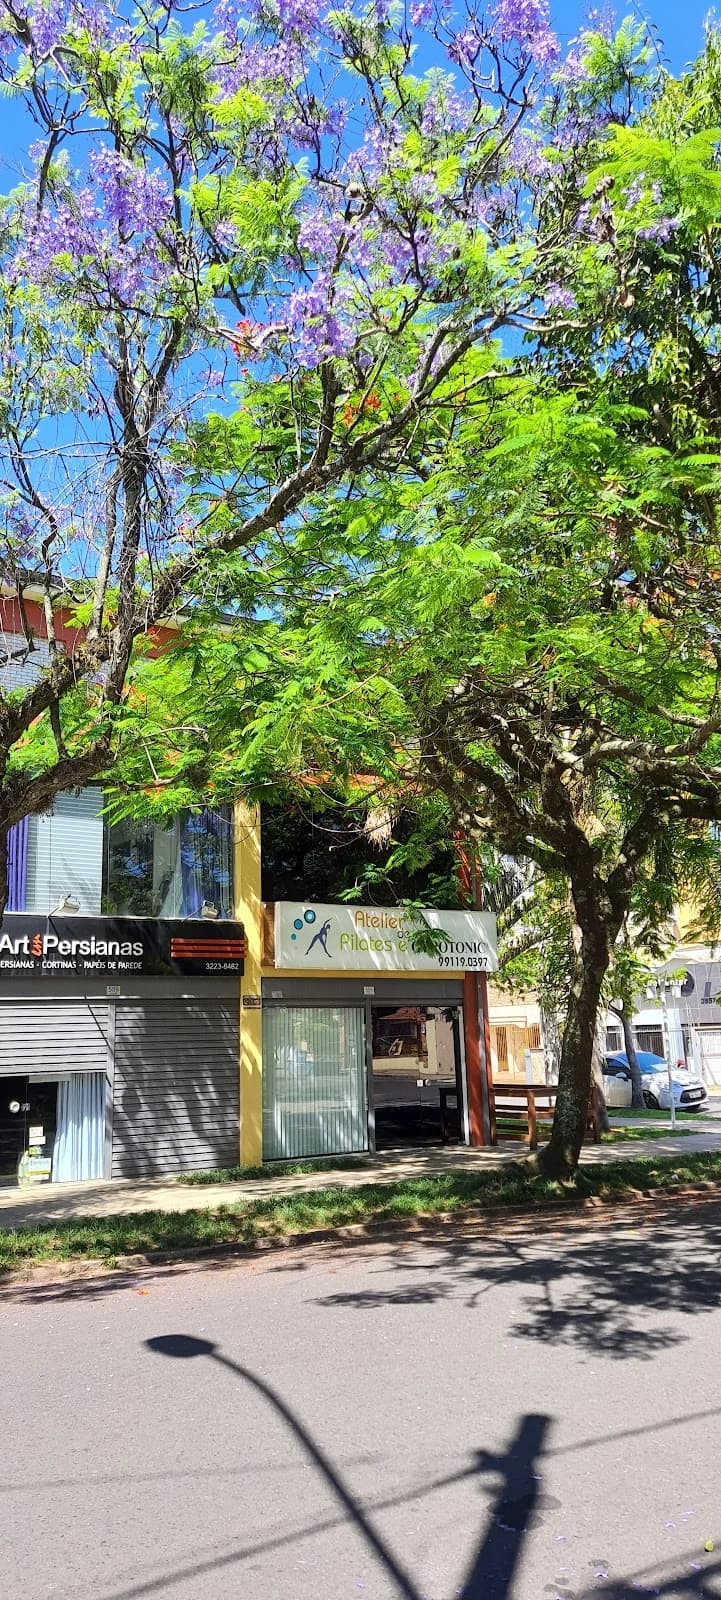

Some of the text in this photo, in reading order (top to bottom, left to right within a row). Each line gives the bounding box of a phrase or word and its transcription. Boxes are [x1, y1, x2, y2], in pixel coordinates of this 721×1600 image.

[354, 910, 404, 929] Atelier
[397, 928, 409, 939] de
[0, 934, 144, 956] Art Persianas
[340, 933, 486, 954] Pilates e OTONIC
[41, 960, 77, 969] CORTINAS
[83, 959, 106, 969] PAPÉIS
[107, 961, 117, 969] DE
[117, 961, 143, 970] PAREDE
[438, 956, 488, 967] 99119.0397
